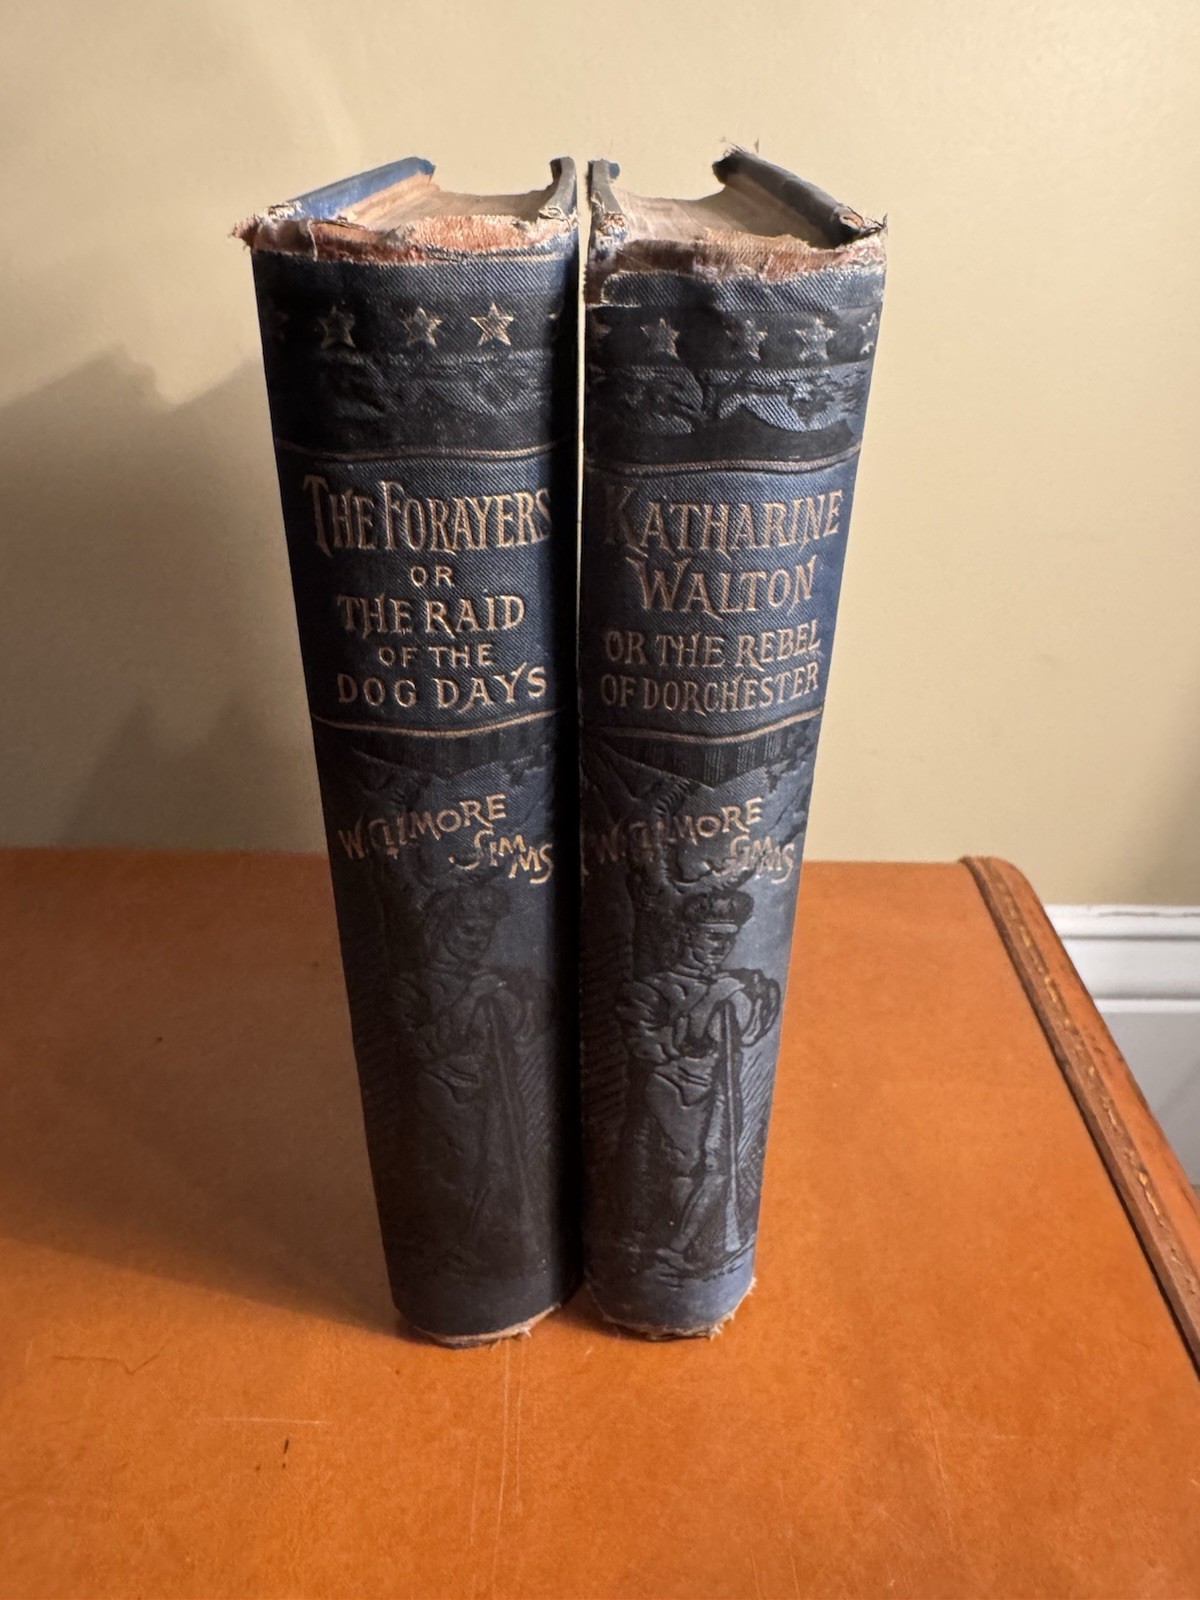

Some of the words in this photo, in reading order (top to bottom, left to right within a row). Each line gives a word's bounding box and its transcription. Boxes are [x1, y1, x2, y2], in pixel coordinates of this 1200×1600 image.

[302, 474, 377, 557] THE
[380, 480, 552, 556] FORAYERS
[602, 488, 844, 560] KATHARINE
[410, 565, 455, 587] OR
[625, 554, 818, 622] WALTON
[337, 592, 413, 638] THE
[424, 595, 526, 638] RAID
[378, 646, 418, 667] OF
[428, 643, 495, 668] THE
[604, 630, 647, 665] OR
[656, 632, 726, 669] THE
[734, 619, 822, 672] REBEL
[337, 673, 417, 708] DOG
[432, 662, 547, 714] DAYS
[602, 674, 638, 706] OF
[643, 661, 820, 717] DORCHESTER
